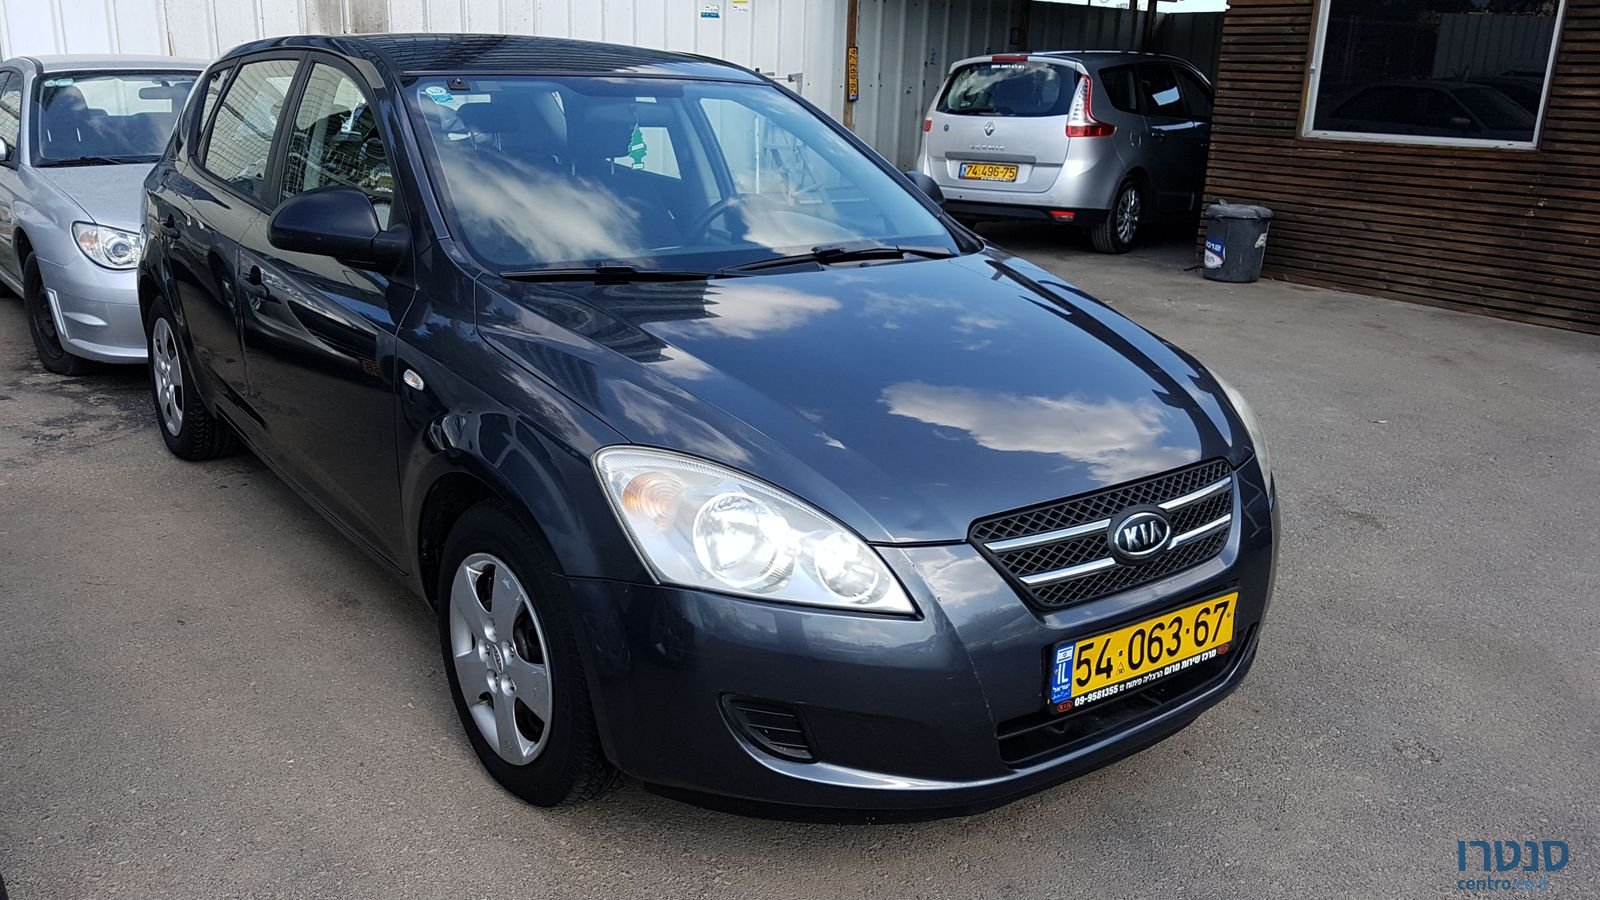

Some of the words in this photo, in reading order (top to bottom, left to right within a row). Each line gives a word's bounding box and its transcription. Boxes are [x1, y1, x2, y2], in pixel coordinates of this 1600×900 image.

[1123, 520, 1163, 551] KIA
[1181, 655, 1201, 669] שירות
[1201, 648, 1216, 661] מרכז
[1057, 662, 1069, 685] IL
[1074, 685, 1119, 707] 09-9581355
